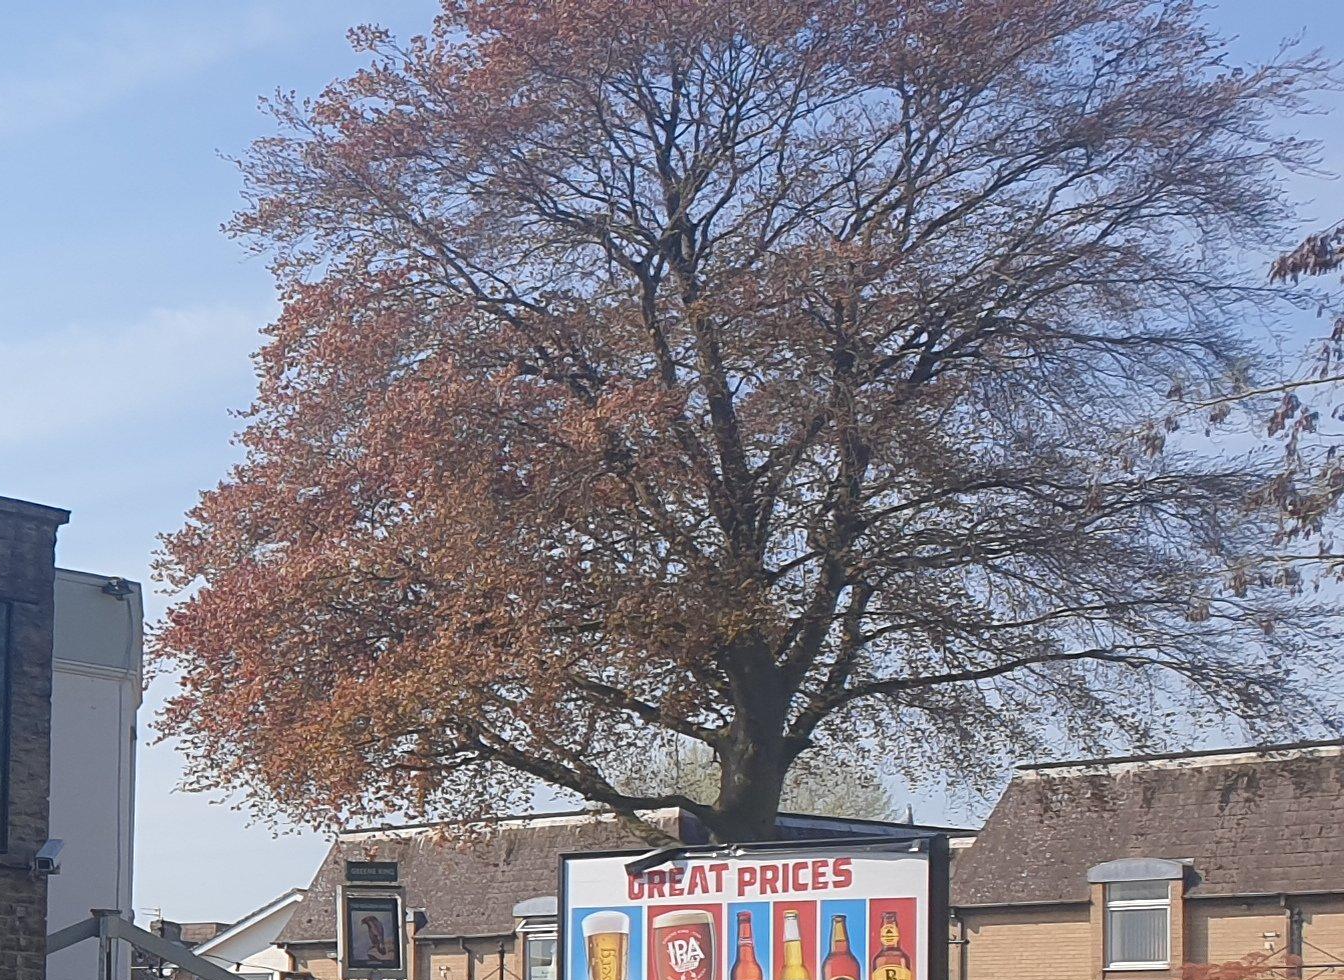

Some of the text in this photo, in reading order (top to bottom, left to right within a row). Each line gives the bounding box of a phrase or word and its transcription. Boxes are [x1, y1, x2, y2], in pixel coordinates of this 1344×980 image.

[628, 857, 853, 900] GREAT PRICES
[666, 936, 706, 968] IPA
